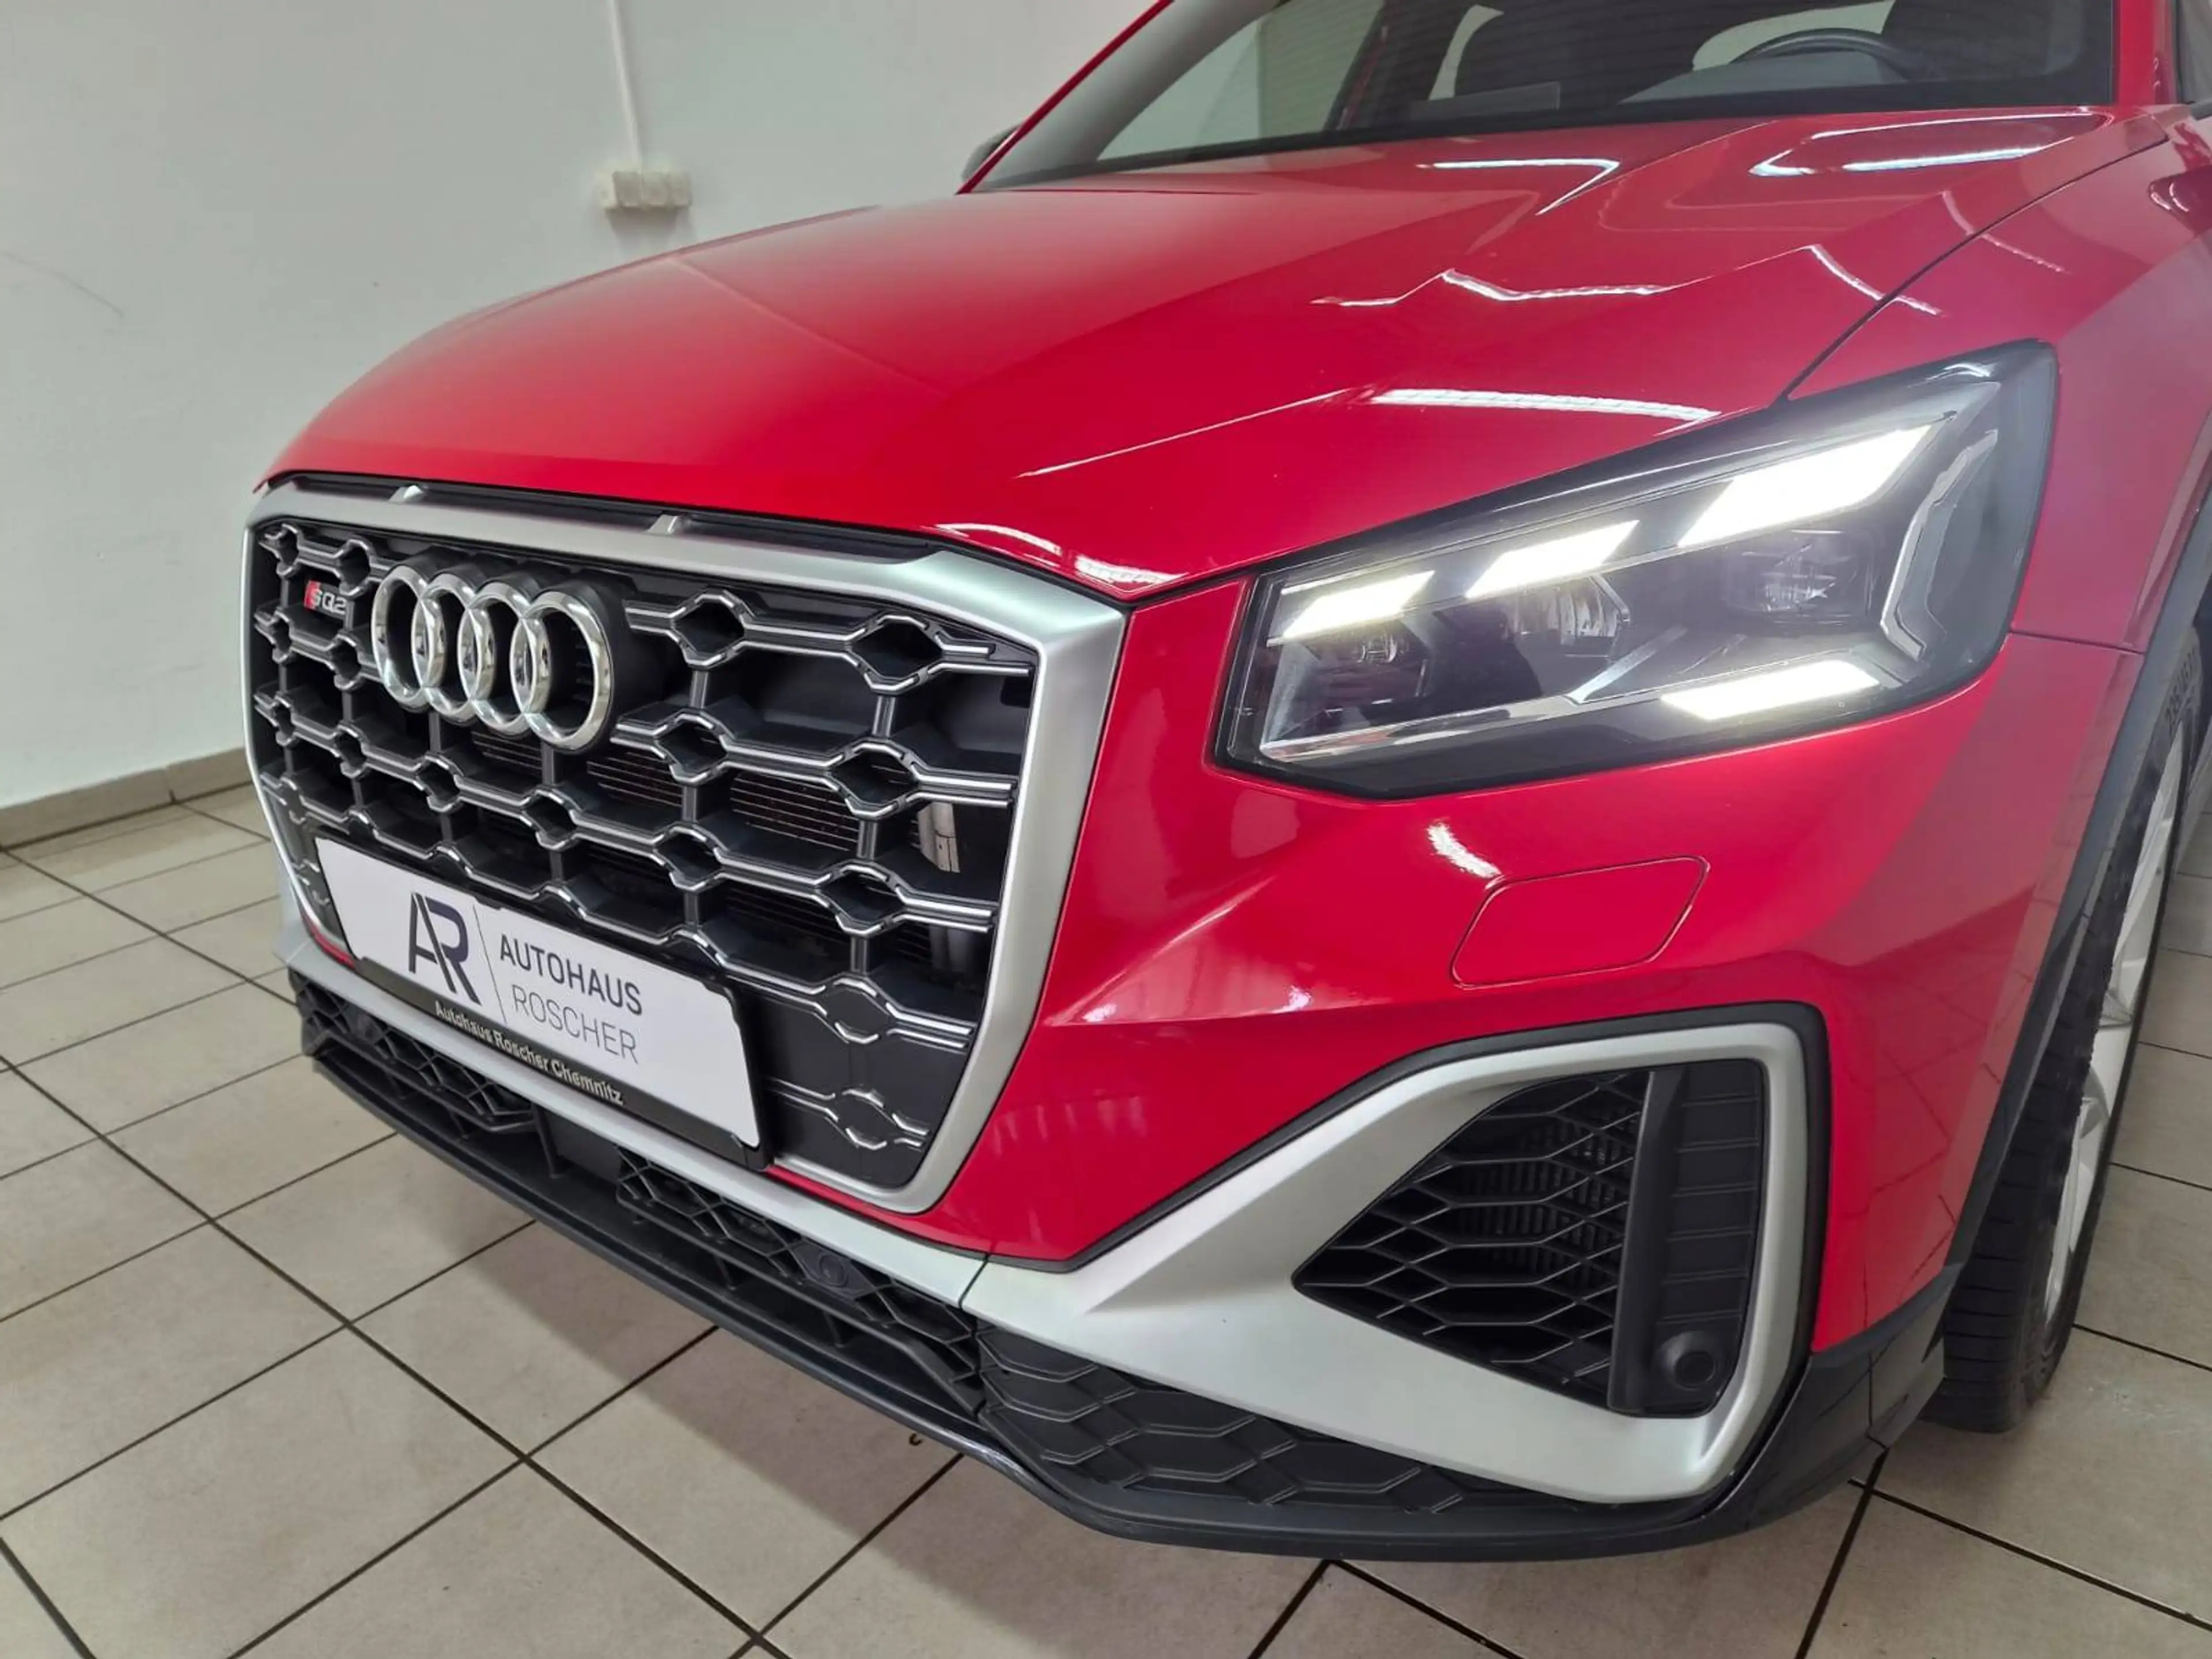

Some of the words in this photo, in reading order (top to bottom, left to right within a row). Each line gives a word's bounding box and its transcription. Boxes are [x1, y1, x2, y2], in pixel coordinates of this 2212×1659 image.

[310, 588, 346, 615] SQ2
[500, 934, 642, 1016] AUTOHAUS
[435, 1000, 493, 1043] Autohaus
[493, 1030, 550, 1071] Roscher
[551, 1060, 623, 1106] Chemnitz
[512, 984, 638, 1064] ROSCHER
